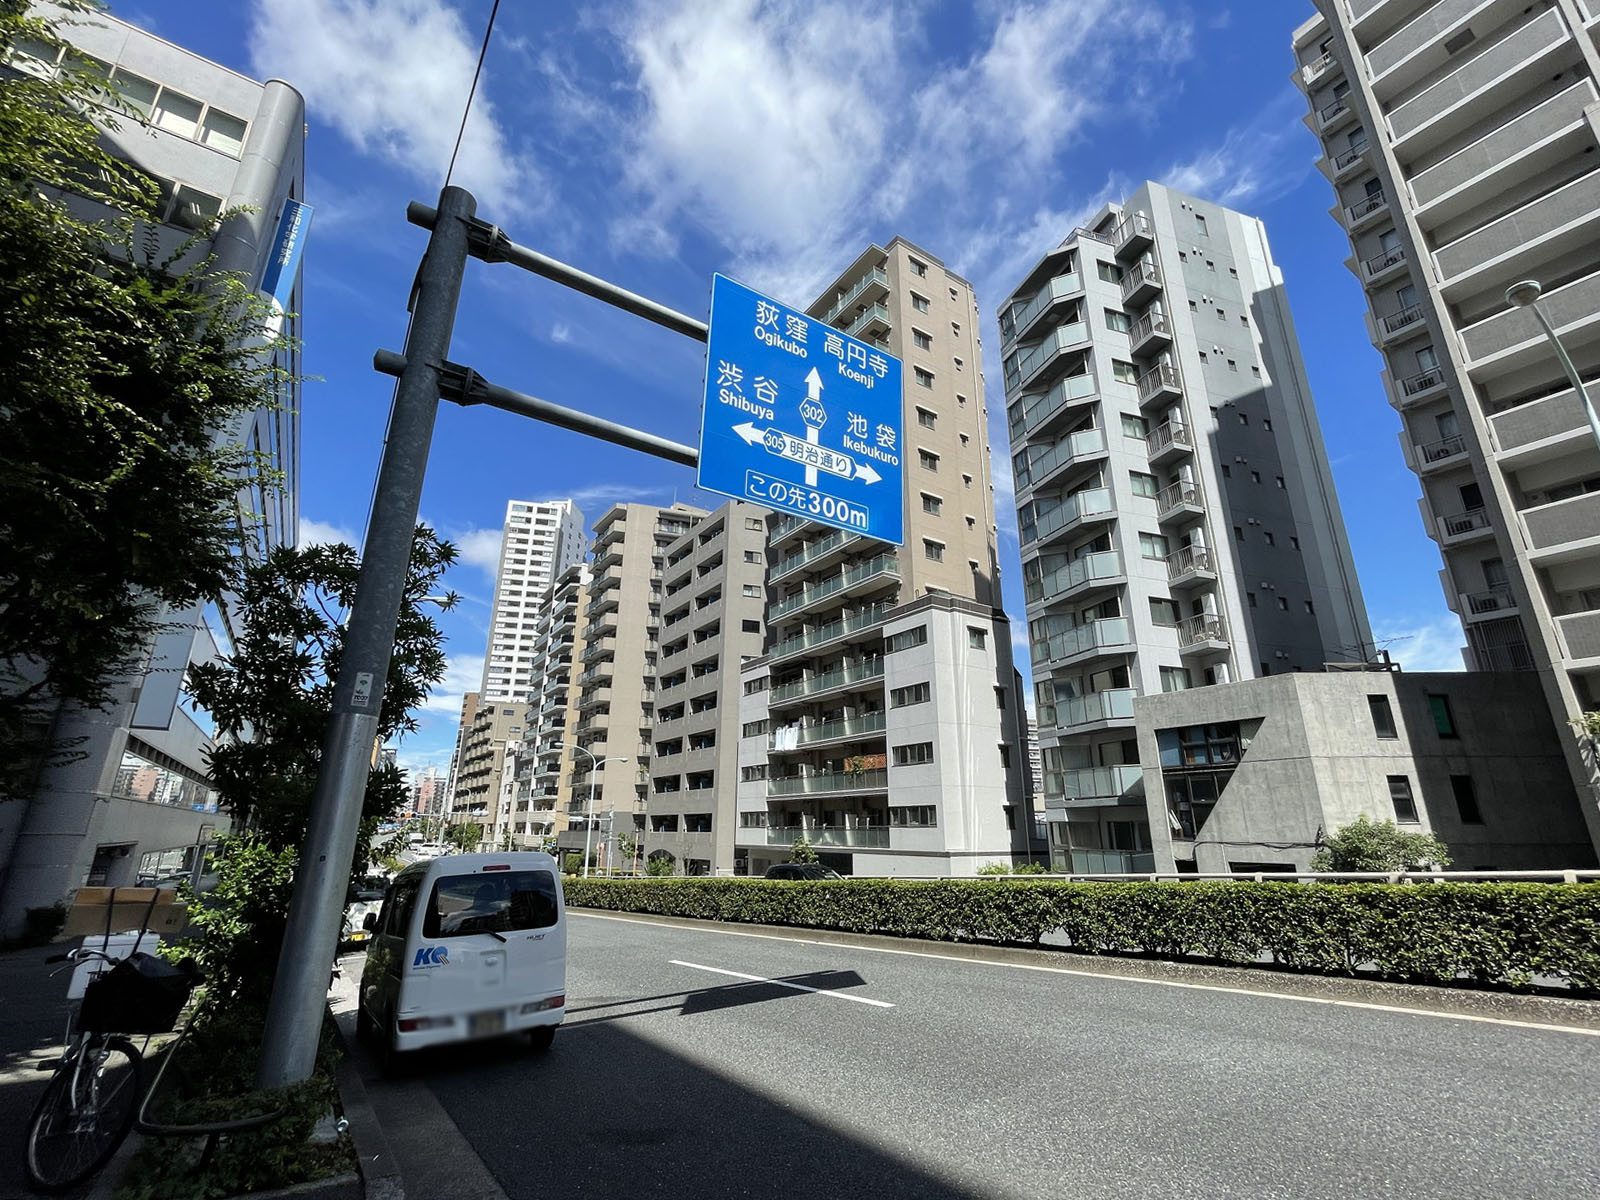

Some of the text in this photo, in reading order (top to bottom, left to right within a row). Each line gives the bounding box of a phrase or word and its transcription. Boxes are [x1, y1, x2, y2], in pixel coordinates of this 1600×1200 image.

[756, 300, 809, 344] 荻窪
[754, 327, 808, 359] Ogikubo
[823, 332, 889, 378] 高円寺
[717, 360, 779, 405] 渋谷
[838, 362, 875, 389] Koenji
[719, 388, 774, 421] Shibuya
[803, 403, 824, 424] 302
[765, 433, 786, 451] 305
[847, 411, 896, 451] 池袋
[790, 442, 848, 473] 明治通り
[843, 434, 899, 467] Ikebukuro
